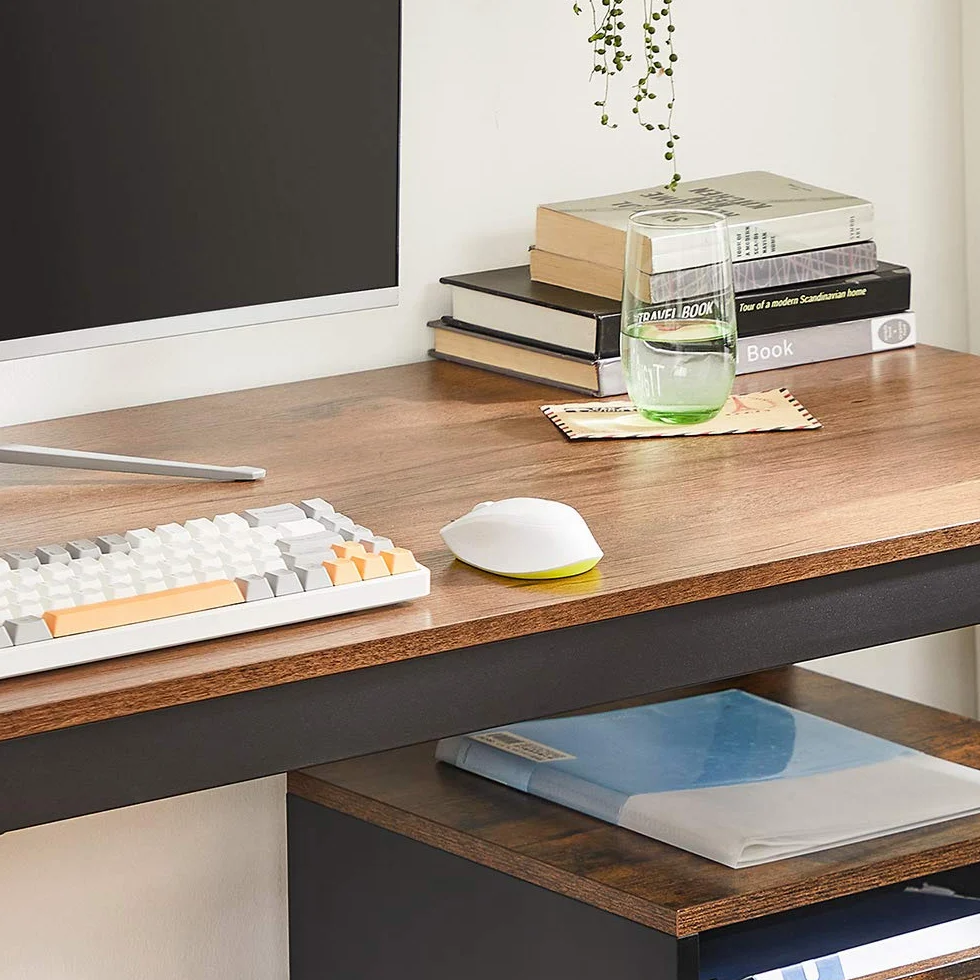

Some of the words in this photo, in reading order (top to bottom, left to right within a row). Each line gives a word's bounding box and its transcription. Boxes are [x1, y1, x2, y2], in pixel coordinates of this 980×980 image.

[681, 301, 714, 319] BOOK
[739, 303, 756, 312] Tour
[756, 300, 766, 310] of
[771, 296, 799, 308] modern
[800, 290, 846, 304] Scandinavian
[847, 288, 867, 298] home
[747, 339, 794, 362] Book
